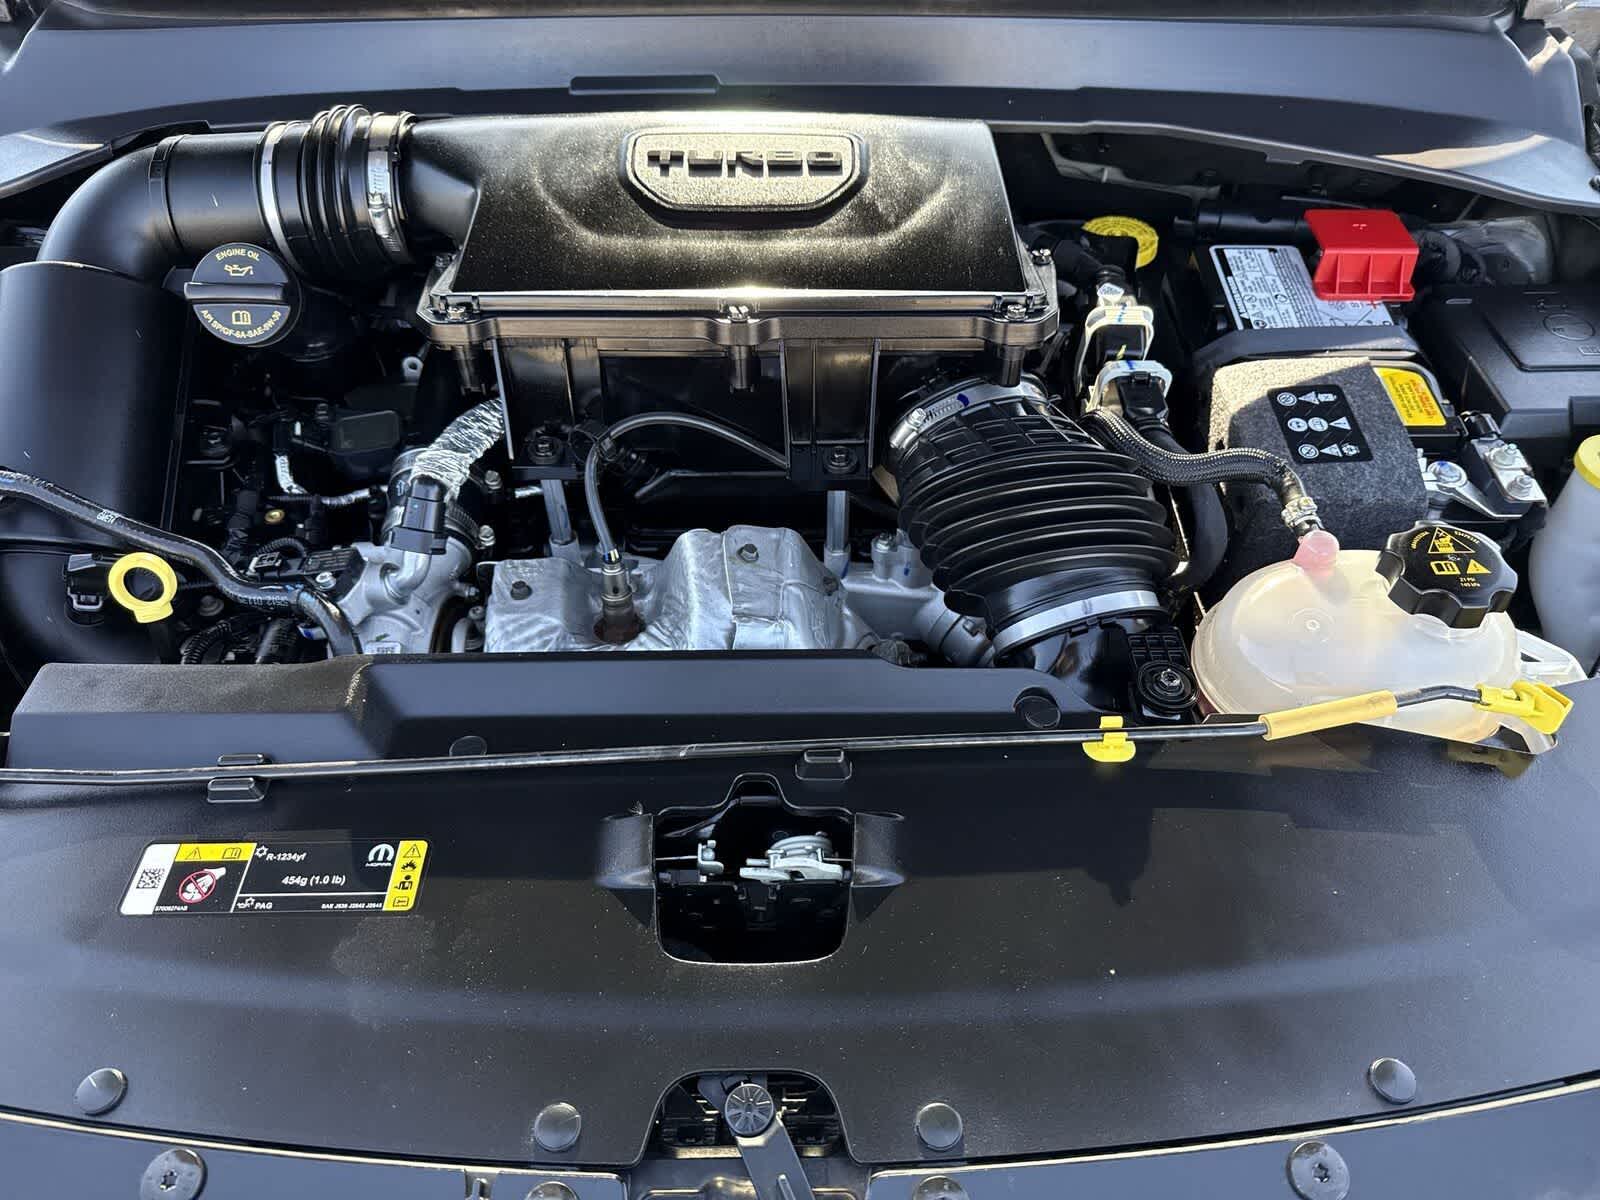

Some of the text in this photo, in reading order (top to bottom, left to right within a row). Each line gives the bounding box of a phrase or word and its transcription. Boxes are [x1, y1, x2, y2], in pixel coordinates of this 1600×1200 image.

[646, 150, 844, 177] TURBO
[215, 248, 260, 261] ENGINE OIL
[265, 852, 307, 861] R-1234yf
[281, 875, 346, 886] 454g (1.0 lb)
